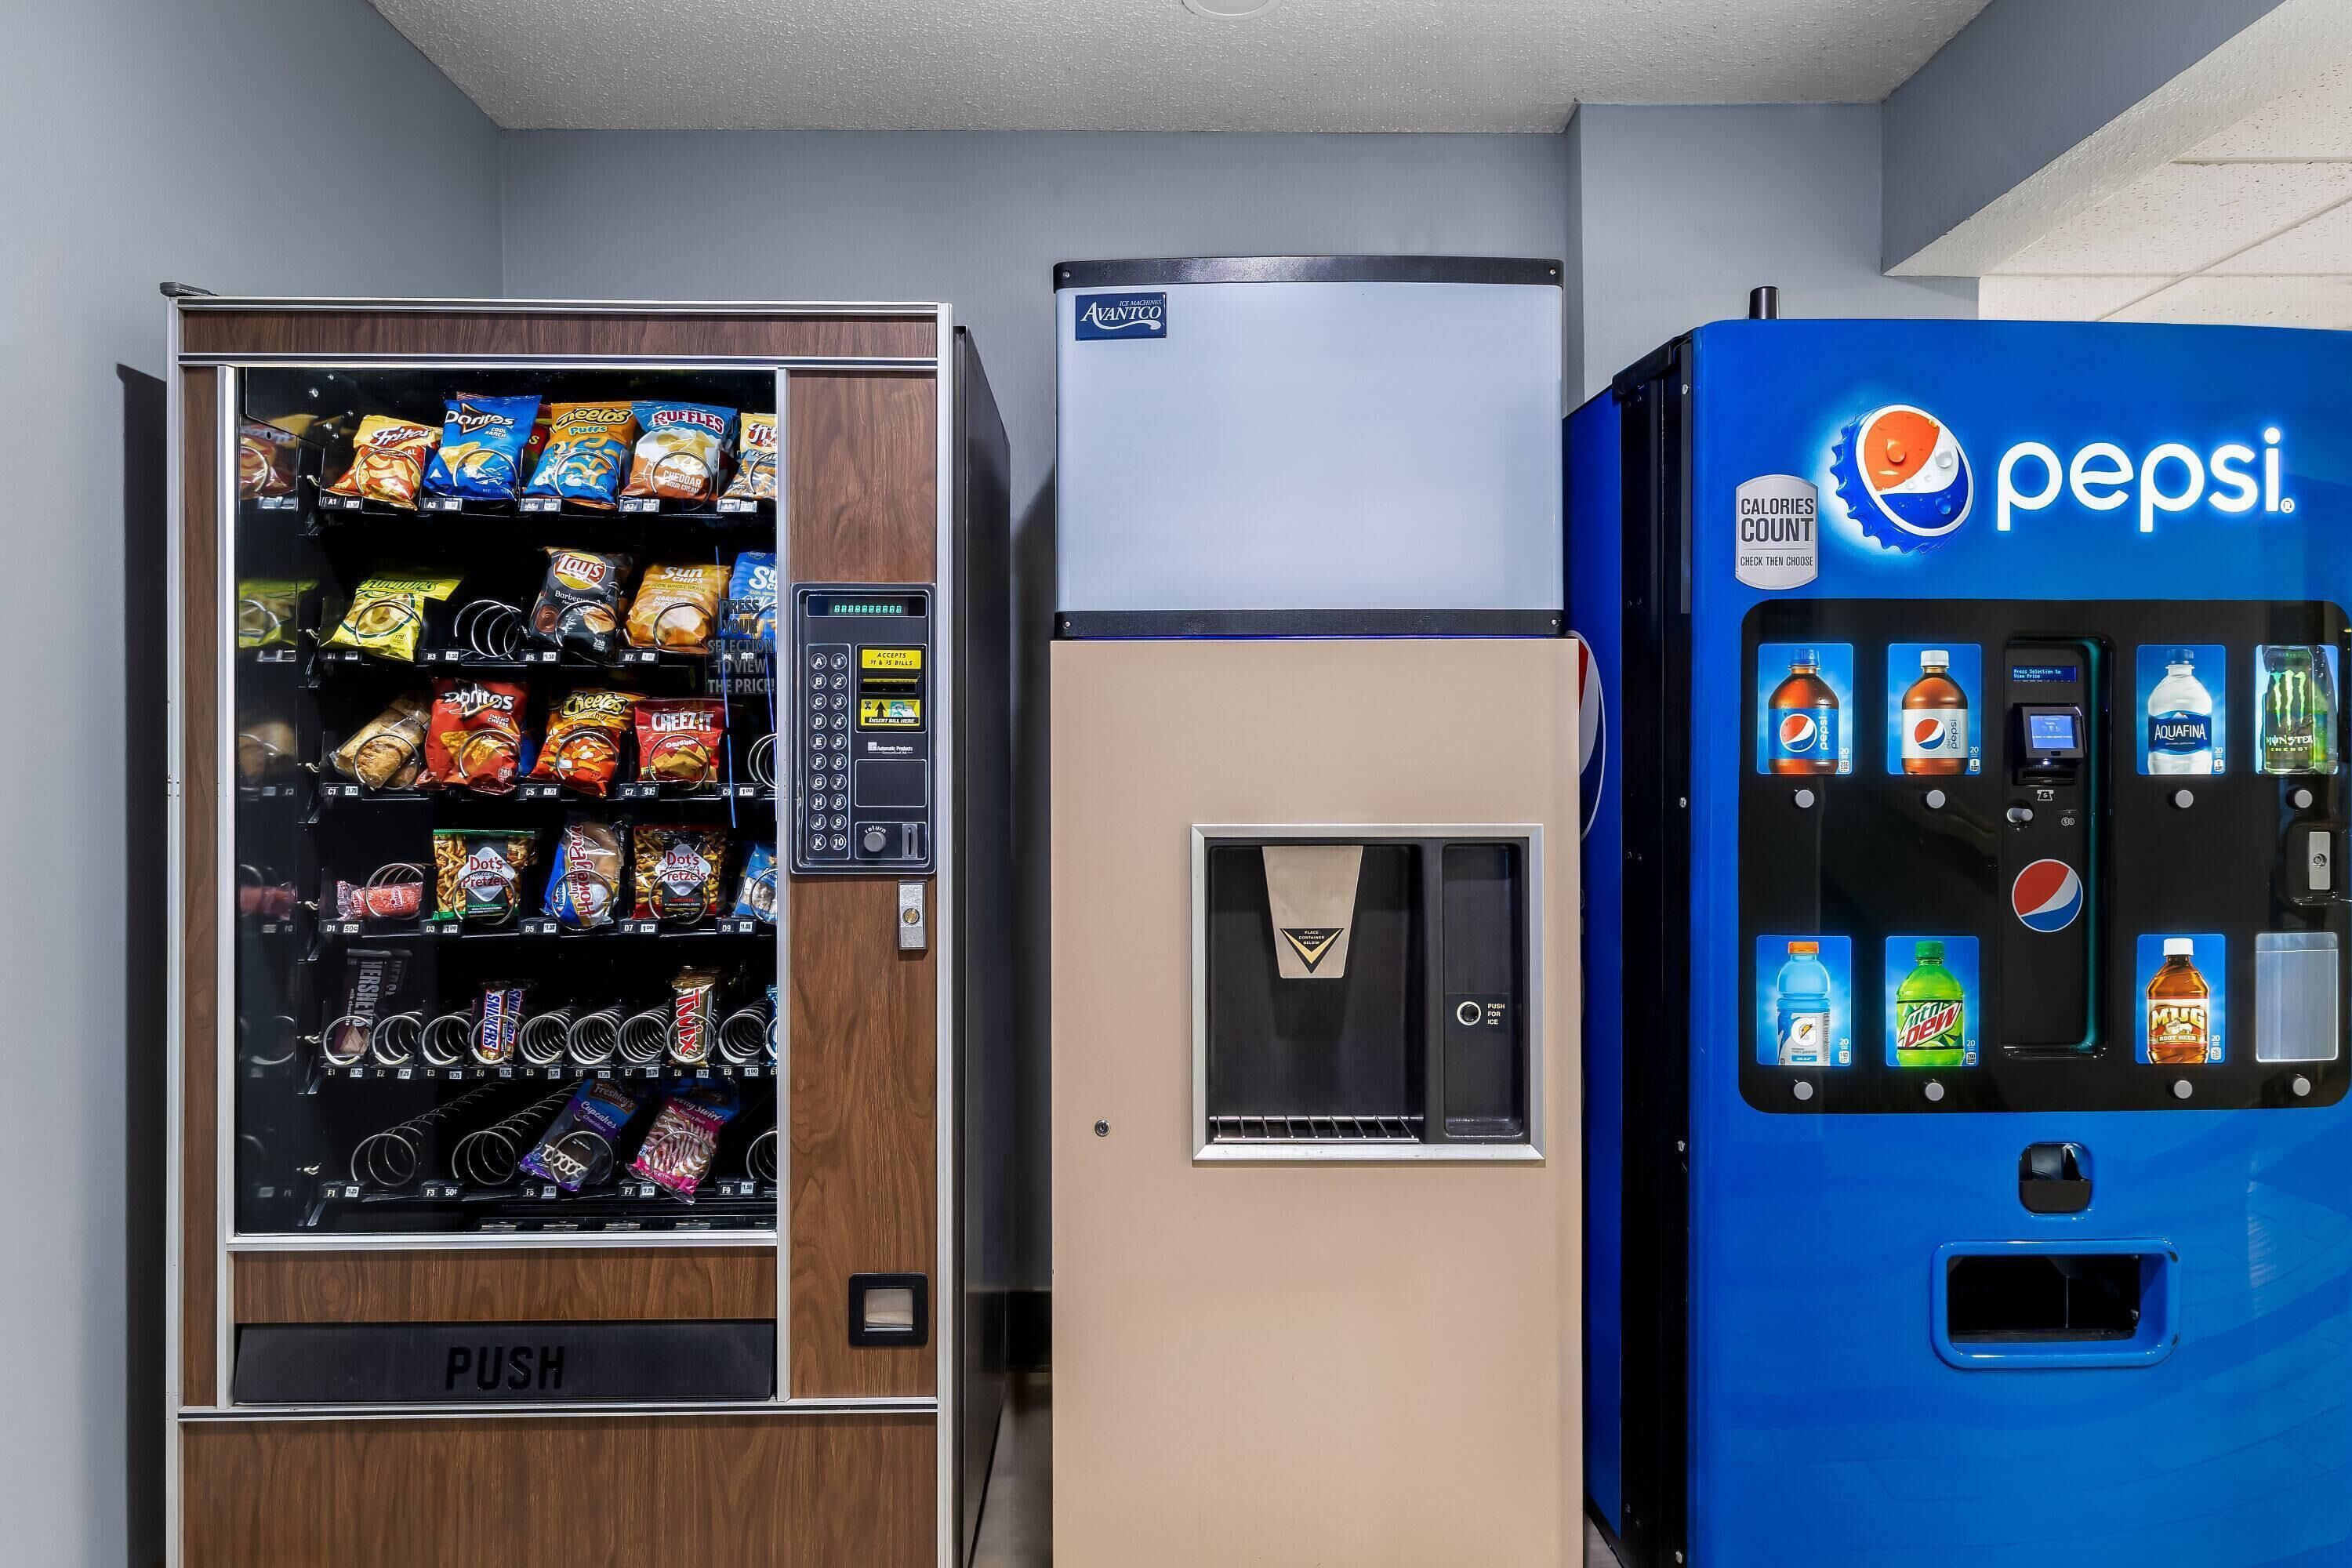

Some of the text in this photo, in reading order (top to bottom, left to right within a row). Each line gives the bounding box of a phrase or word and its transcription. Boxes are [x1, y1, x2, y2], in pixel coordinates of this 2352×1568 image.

[1080, 302, 1162, 324] AVANTCO
[445, 409, 515, 426] Doritos
[652, 410, 724, 435] RUFFLES
[372, 426, 432, 446] Fritos
[568, 426, 608, 436] Puffs
[663, 470, 702, 488] CHEDDAR
[1997, 427, 2281, 533] pepsi
[681, 485, 699, 494] CREAM
[1741, 498, 1814, 515] CALORIES
[1741, 518, 1813, 543] COUNT
[1740, 556, 1813, 567] CHECK THEN CHOOSE
[660, 566, 703, 580] Sun
[721, 600, 760, 614] PRESS
[723, 619, 758, 634] YOUR
[594, 637, 605, 646] 230
[707, 639, 774, 654] SELECTION
[716, 659, 766, 673] TO VIEW
[708, 678, 775, 693] THE PRICE!
[563, 691, 626, 716] Cheetos
[487, 717, 510, 728] CHEESE
[490, 713, 510, 723] NACHO
[1818, 716, 1829, 750] pepsi
[1950, 719, 1958, 750] pepsi
[2154, 724, 2207, 741] AQUAFINA
[2266, 735, 2313, 746] MONSTER
[865, 825, 887, 833] return
[470, 856, 503, 871] Dot's
[667, 851, 700, 866] Dot's
[568, 825, 596, 916] Honey Bun
[484, 993, 500, 1048] SNICKERS
[2151, 1007, 2205, 1030] MUG
[581, 1101, 617, 1129] Cupcakes
[678, 1109, 695, 1120] Honey
[583, 1115, 607, 1132] Chocolate
[445, 1345, 564, 1392] PUSH
